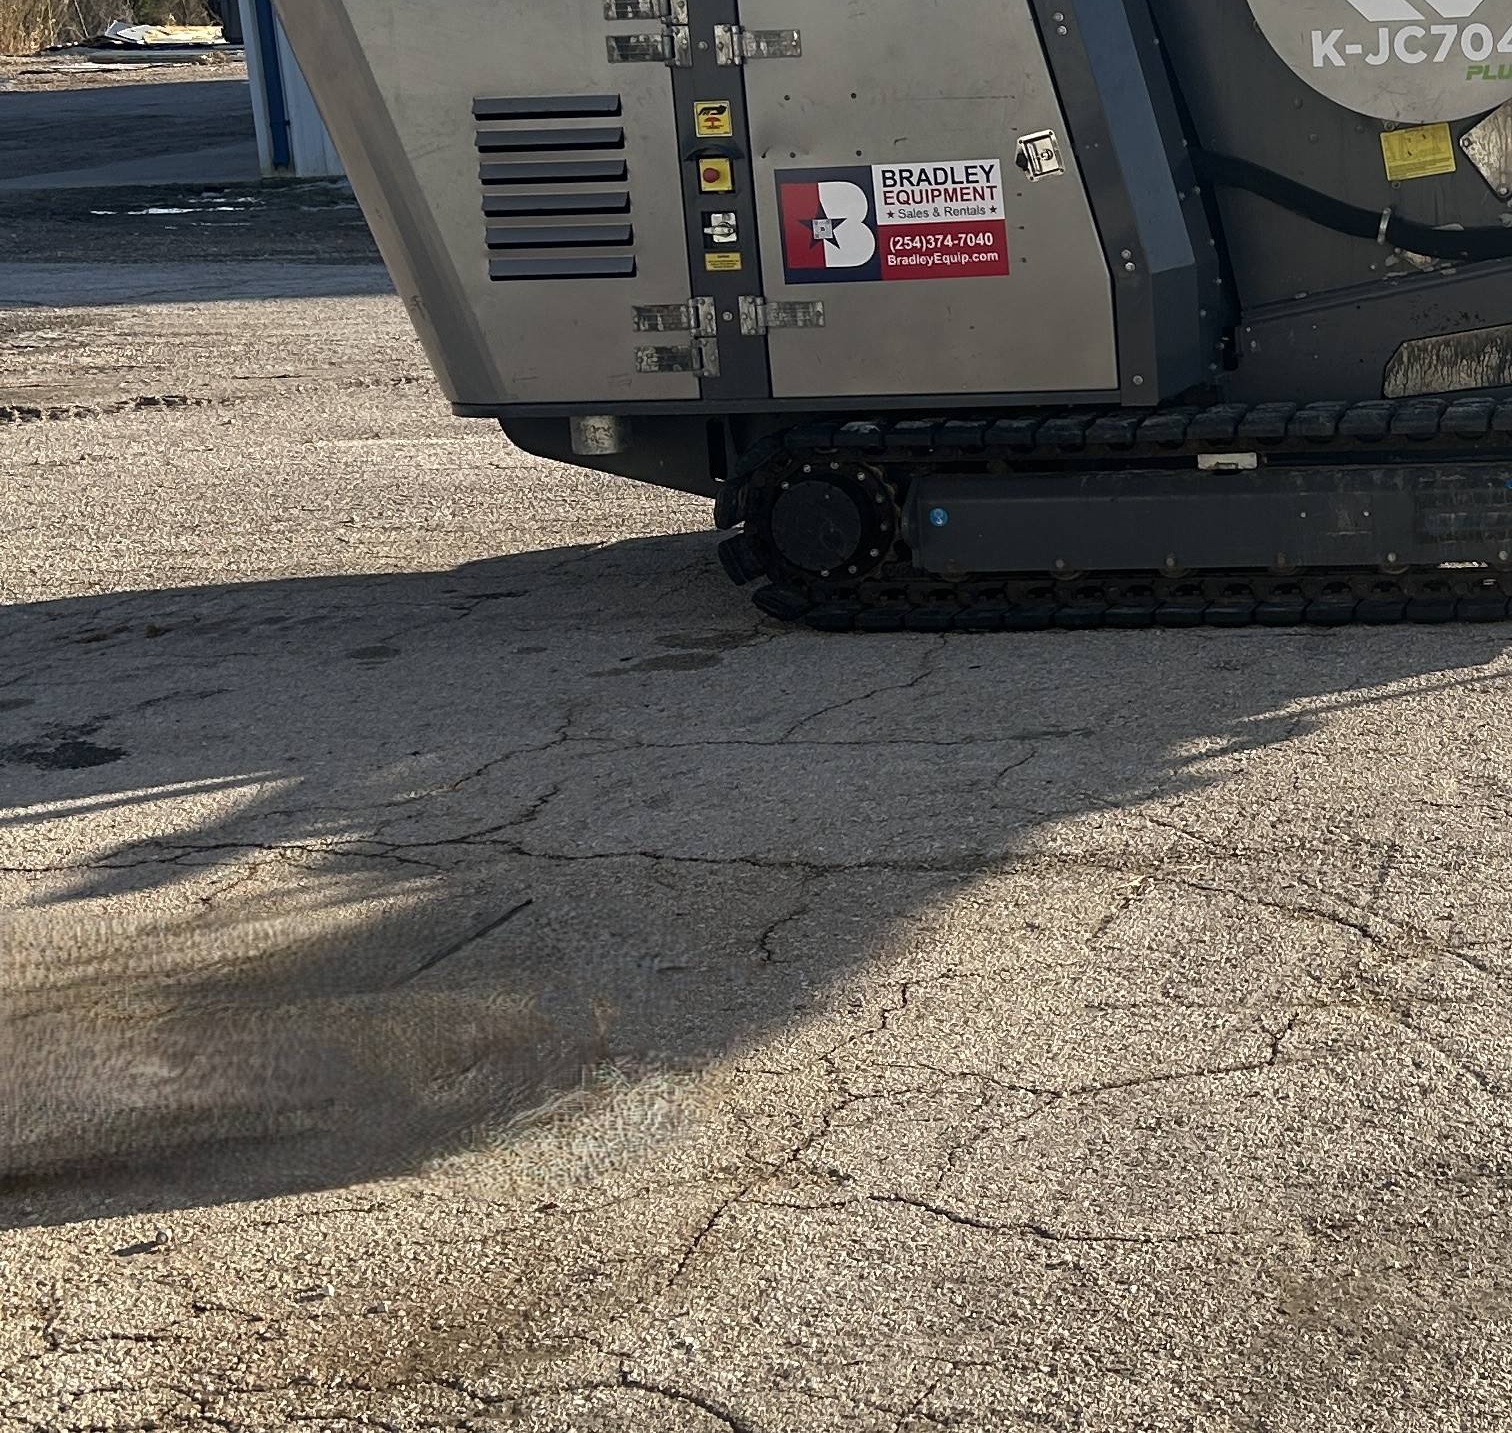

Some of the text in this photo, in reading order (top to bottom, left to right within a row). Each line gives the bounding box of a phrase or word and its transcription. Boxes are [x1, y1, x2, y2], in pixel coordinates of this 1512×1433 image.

[881, 164, 995, 188] BRADLEY
[883, 185, 998, 206] EQUIPMENT
[897, 205, 986, 219] Sales & Rentals
[780, 181, 876, 270] B
[889, 232, 994, 253] (254)374-7040
[887, 251, 999, 267] BradleyEquip.com
